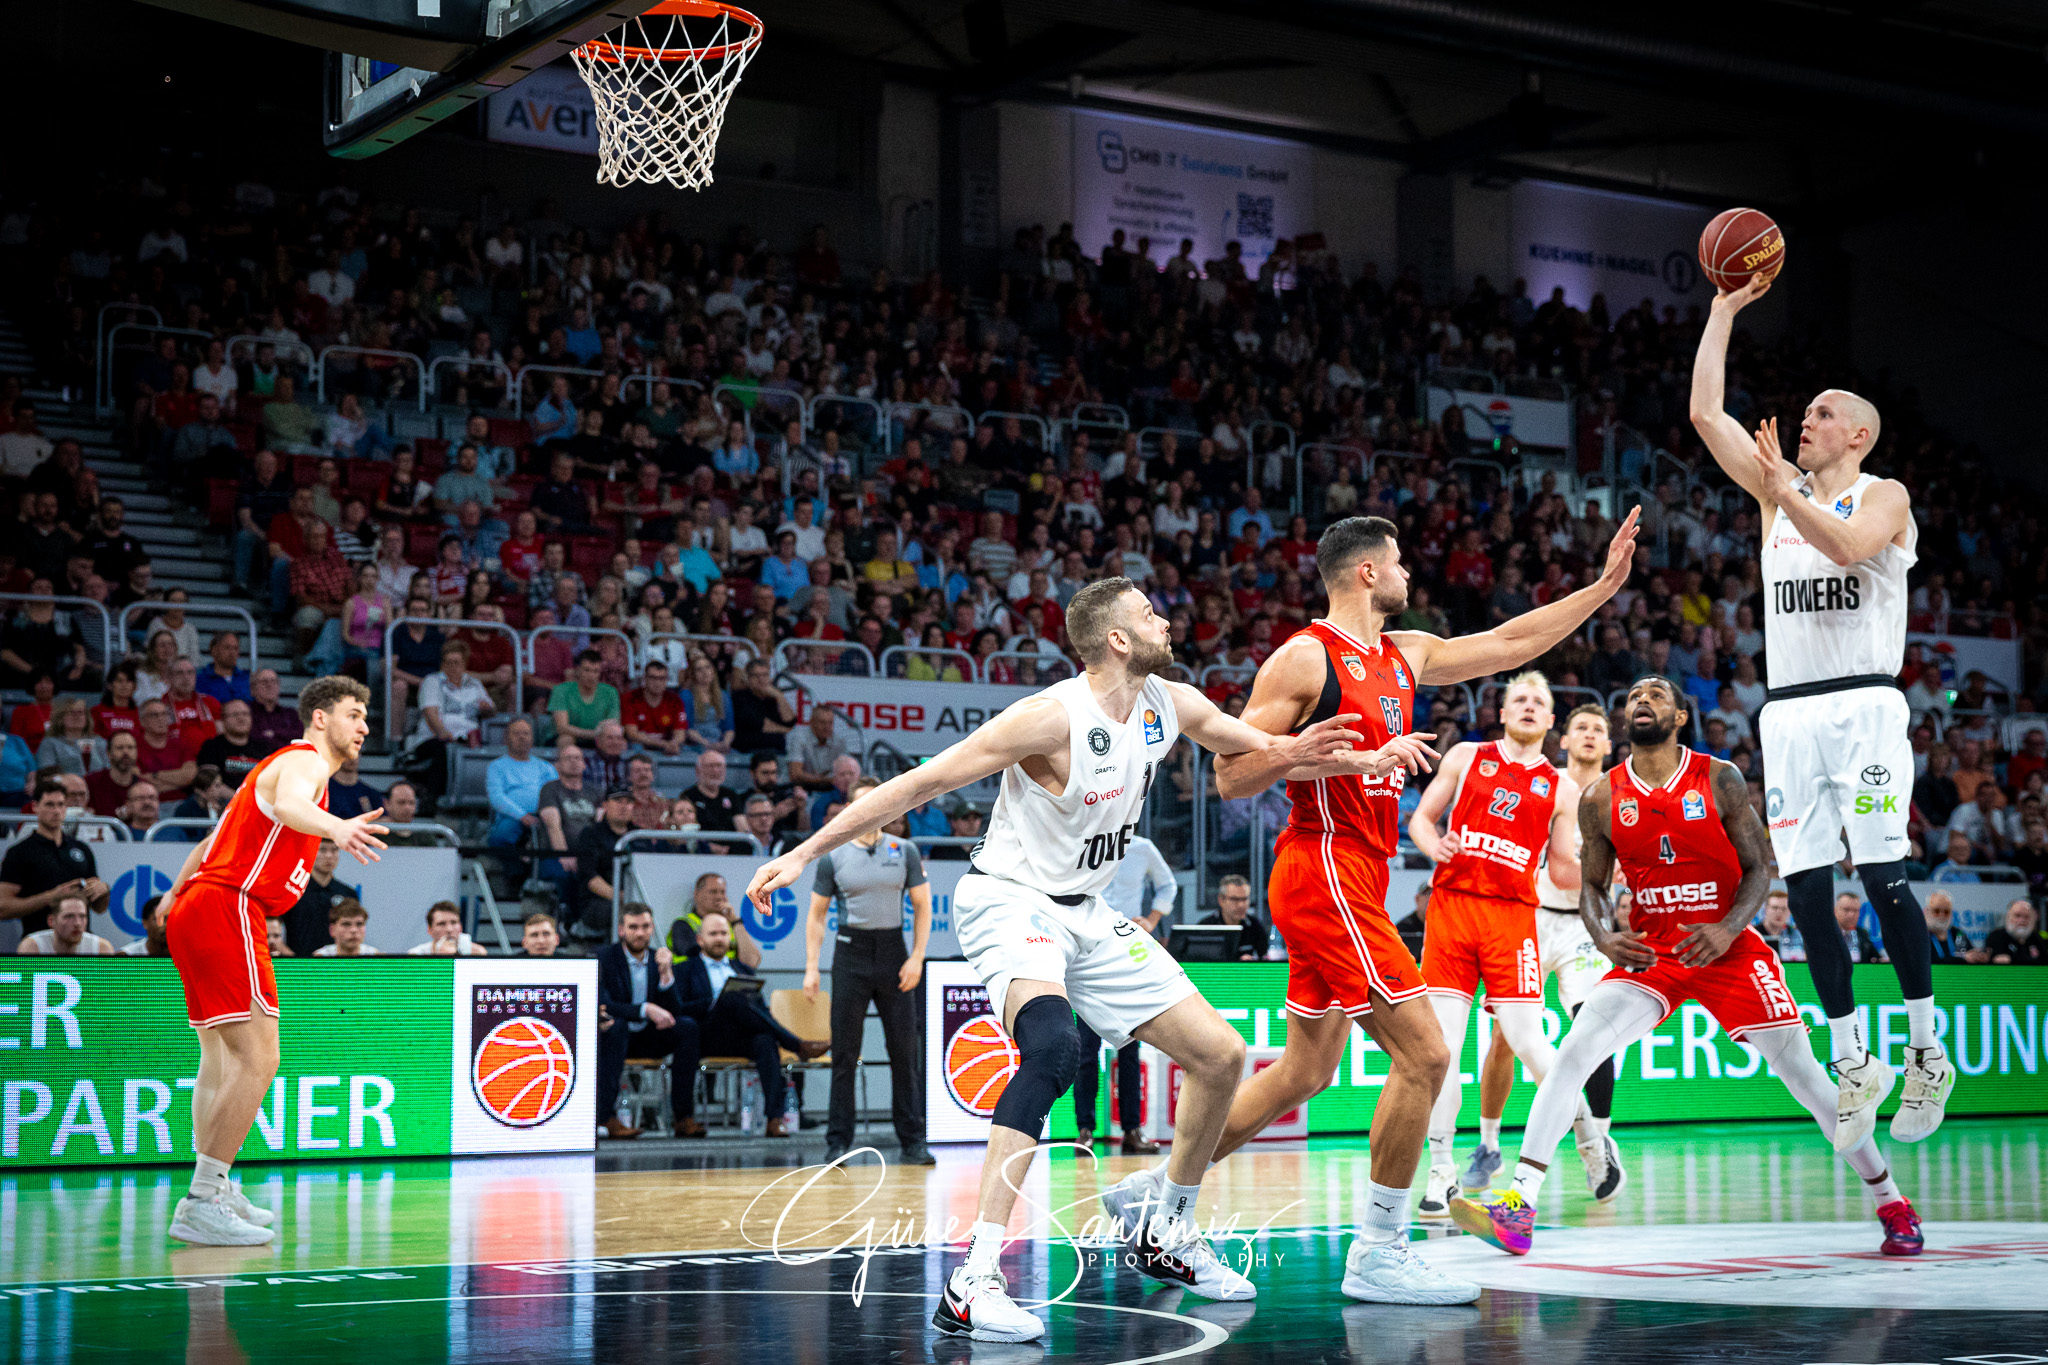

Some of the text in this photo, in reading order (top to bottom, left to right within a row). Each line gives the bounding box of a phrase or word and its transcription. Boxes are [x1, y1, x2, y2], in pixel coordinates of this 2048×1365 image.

[1774, 575, 1860, 614] TOWERS
[1379, 696, 1403, 736] 65
[1095, 766, 1112, 774] CRAFT
[1141, 758, 1164, 801] 1
[1488, 787, 1522, 822] 22
[1855, 795, 1898, 815] S+K
[1461, 824, 1532, 866] brose
[1659, 834, 1676, 864] 4
[2, 1074, 397, 1157] PARNER
